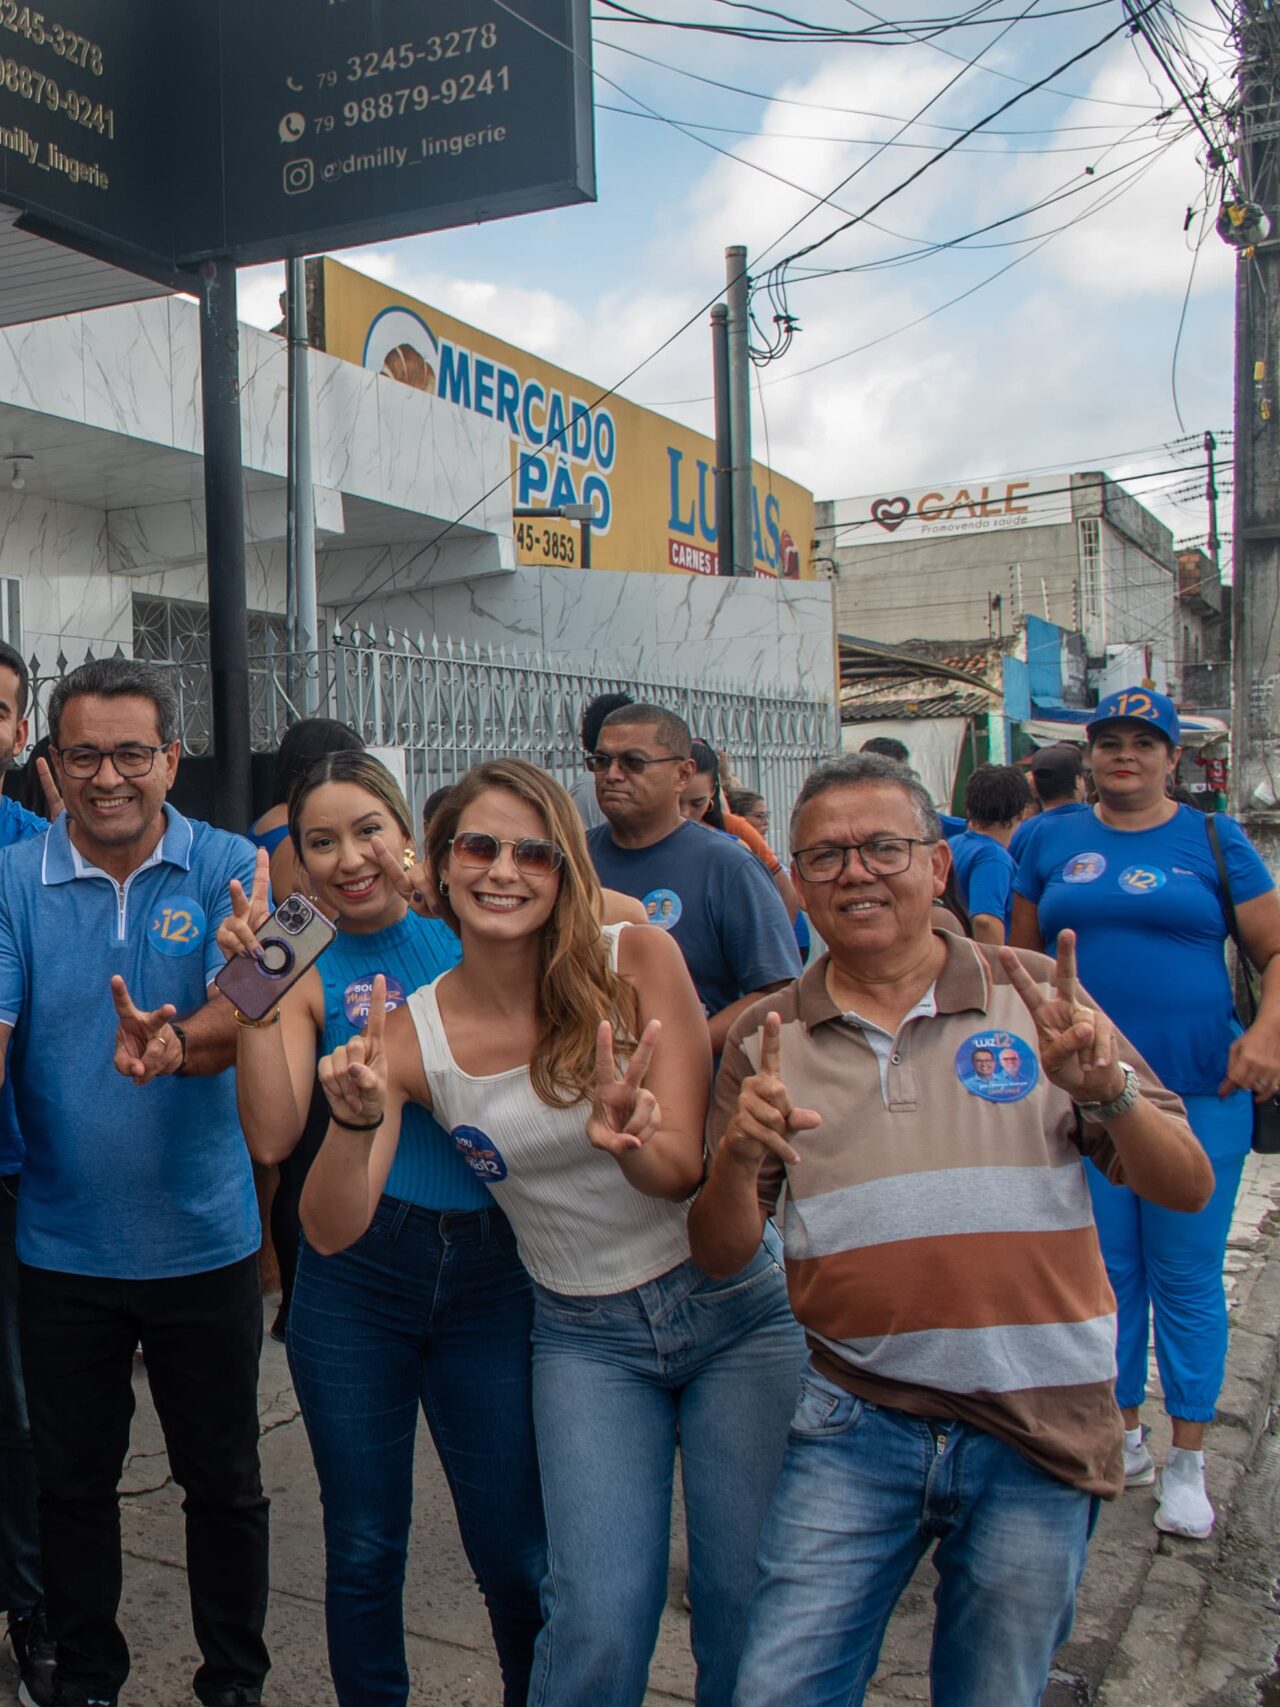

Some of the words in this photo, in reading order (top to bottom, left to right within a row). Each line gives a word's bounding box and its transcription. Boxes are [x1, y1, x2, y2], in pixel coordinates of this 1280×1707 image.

[317, 71, 338, 89] 79
[346, 22, 498, 82] 3245-3278
[313, 116, 335, 134] 79
[343, 65, 511, 127] 98879-9241
[437, 342, 615, 471] MERCADO
[519, 452, 611, 530] PÃO
[514, 523, 576, 564] 45-3853
[671, 542, 712, 576] CARNES
[1117, 693, 1153, 720] 12
[161, 908, 192, 942] 12
